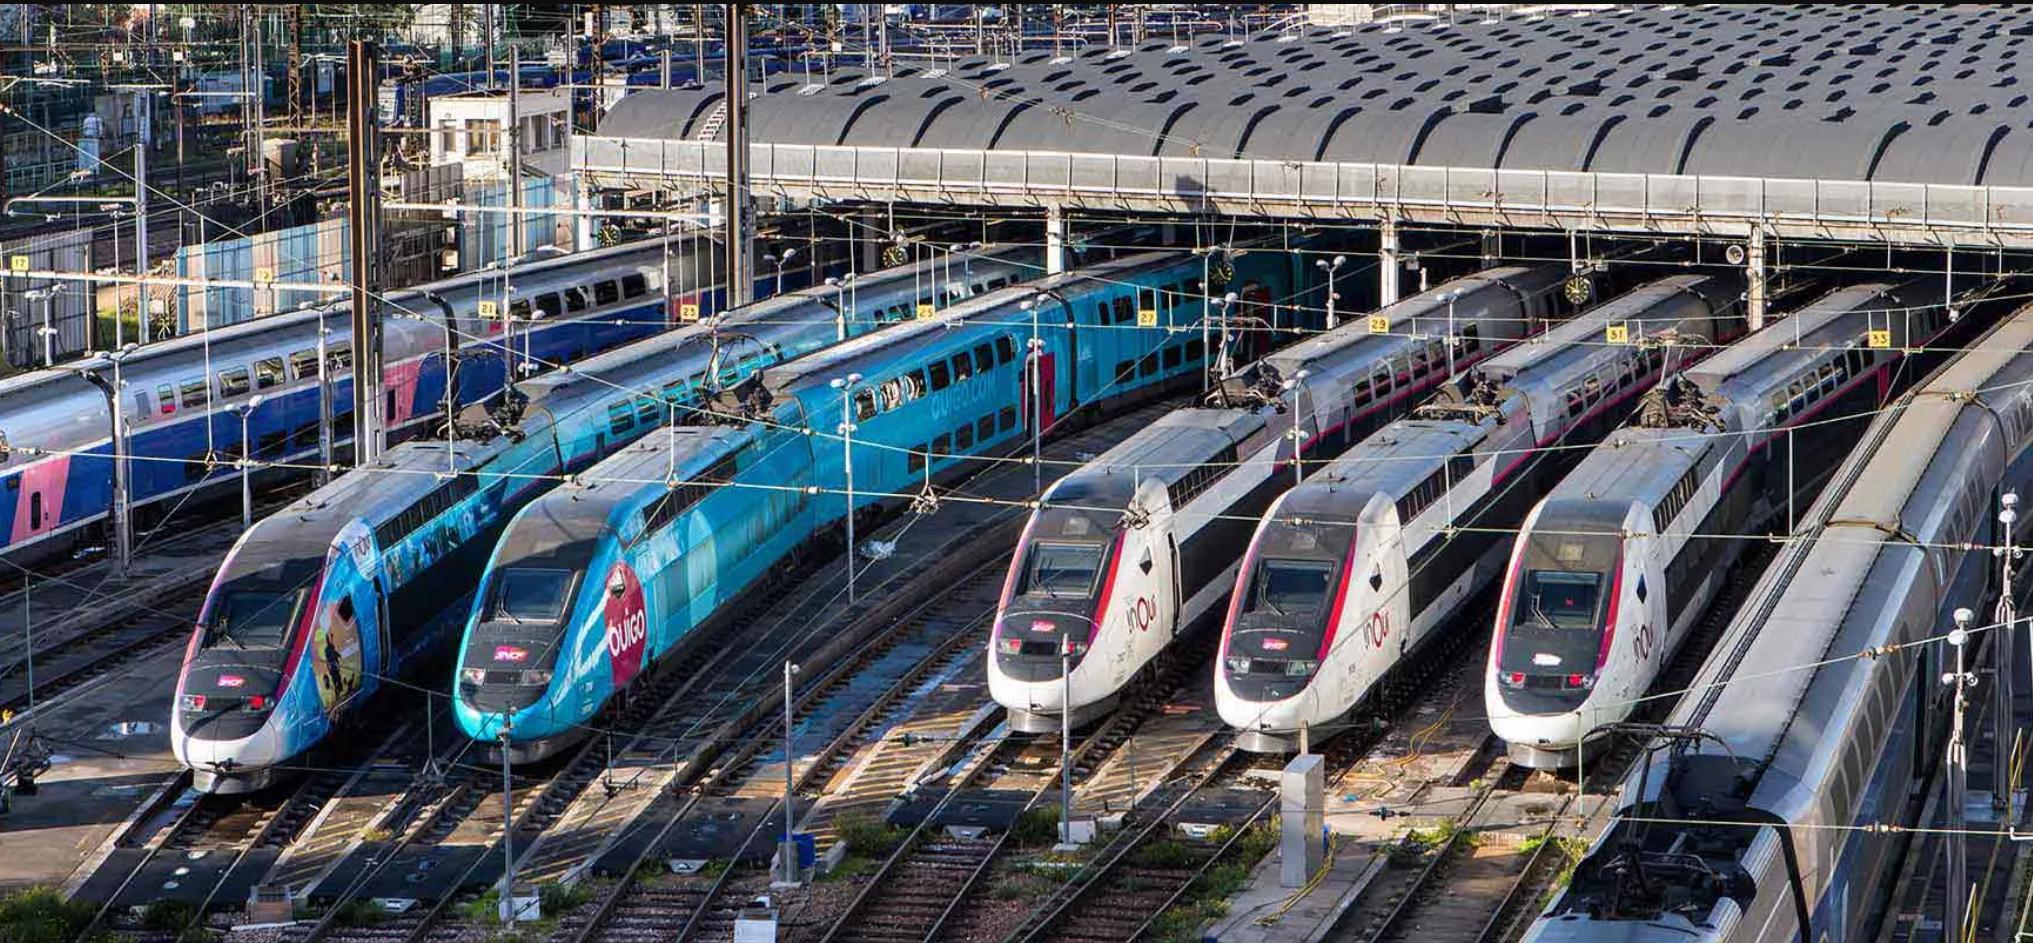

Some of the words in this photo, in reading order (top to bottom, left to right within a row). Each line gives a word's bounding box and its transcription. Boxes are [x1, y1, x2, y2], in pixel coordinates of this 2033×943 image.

[481, 303, 493, 314] 21
[1140, 313, 1154, 323] 27
[1371, 320, 1386, 330] 29
